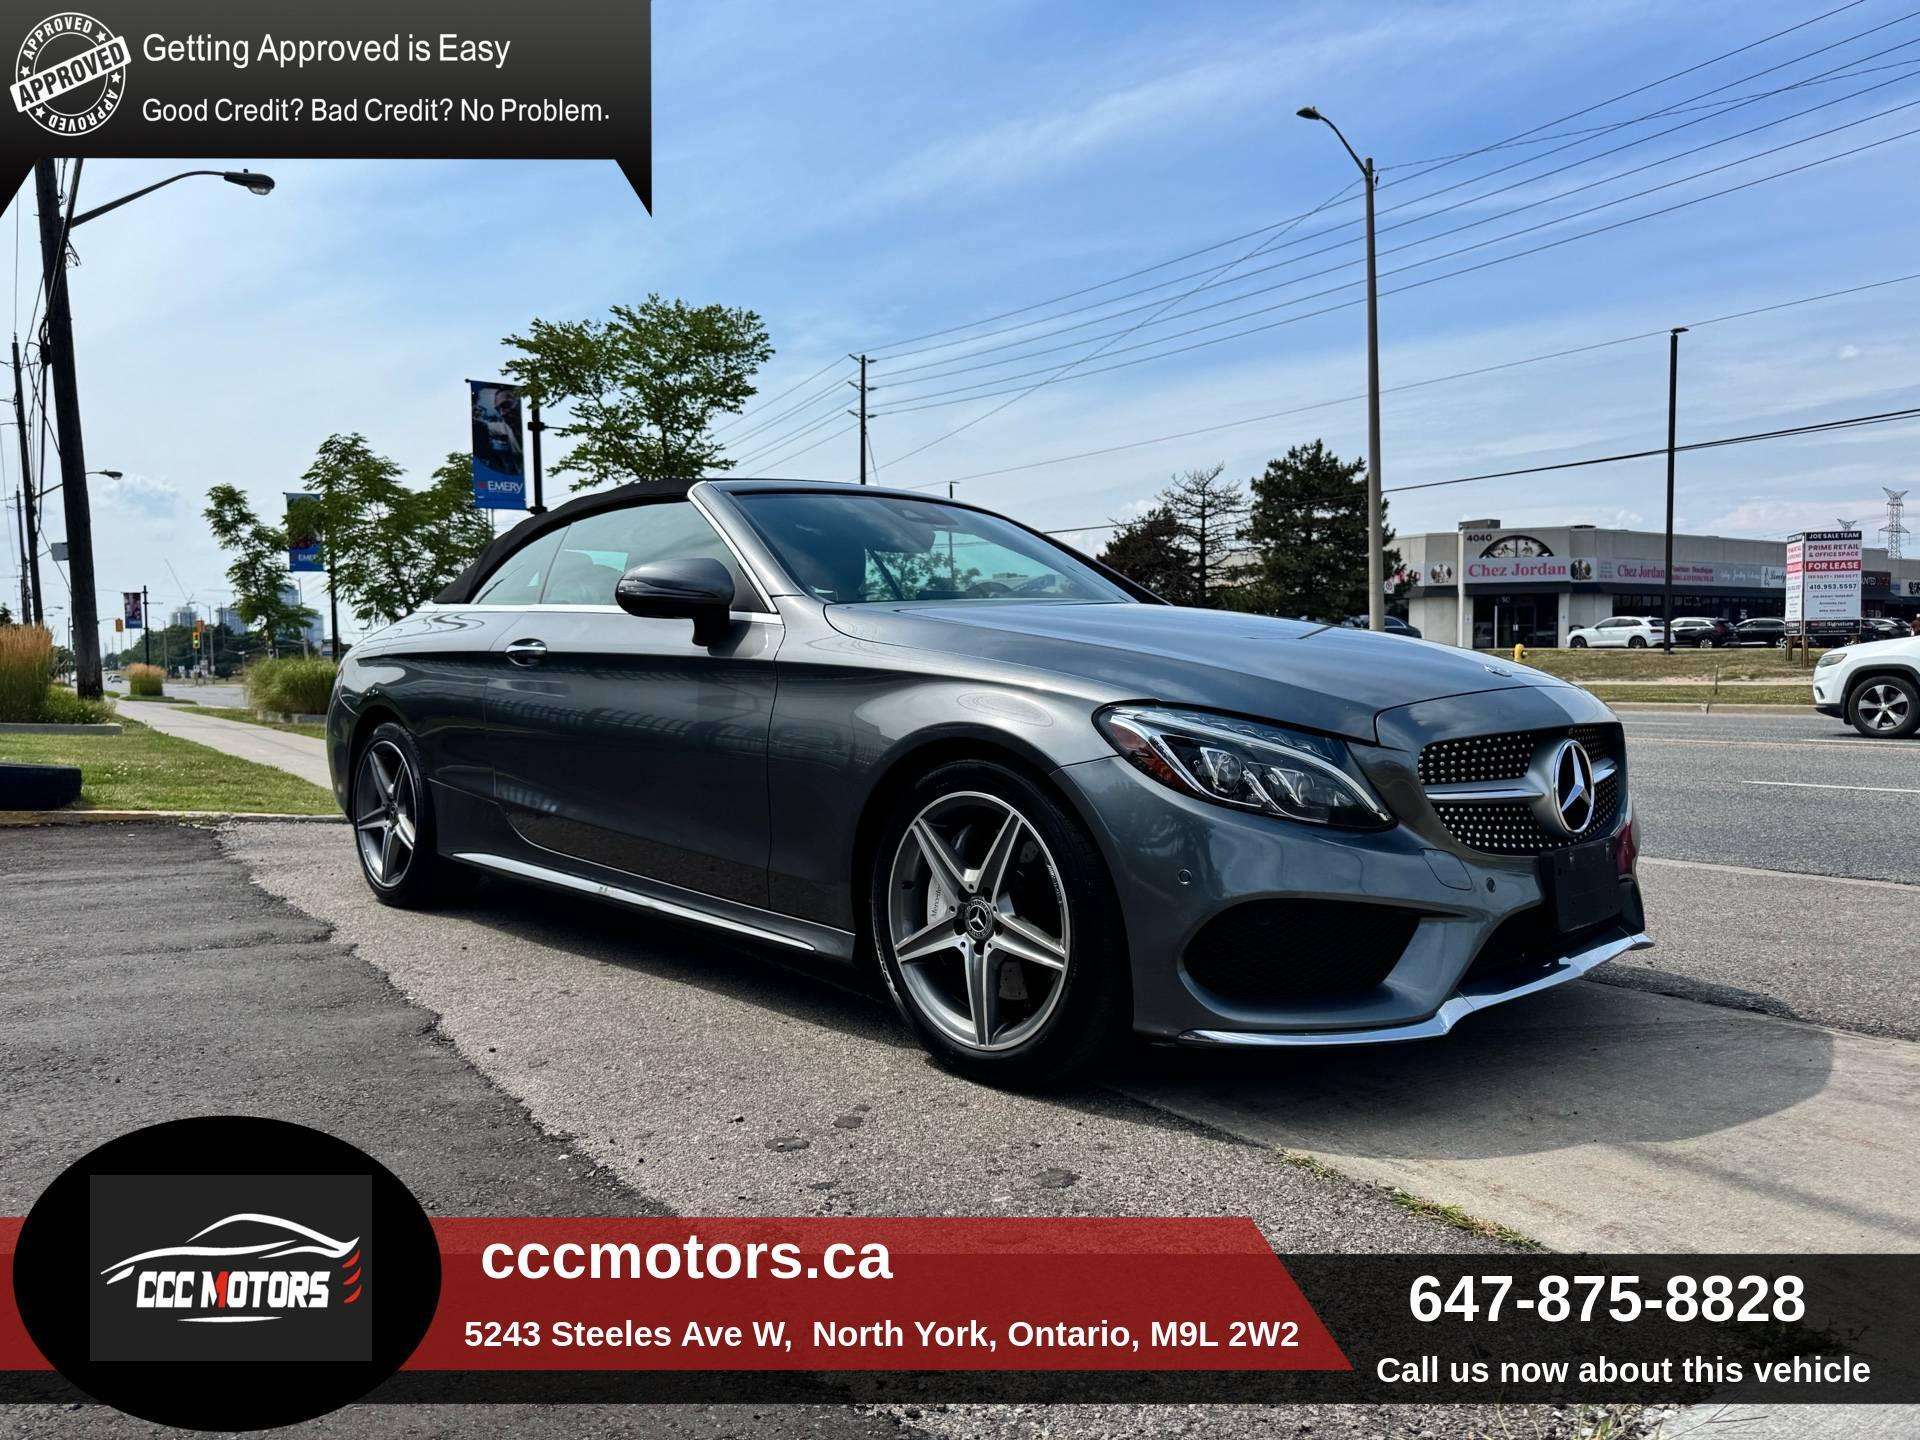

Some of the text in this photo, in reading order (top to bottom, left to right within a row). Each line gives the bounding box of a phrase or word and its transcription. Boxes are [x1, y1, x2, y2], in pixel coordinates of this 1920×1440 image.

[1467, 534, 1493, 542] 4040
[1468, 563, 1567, 577] Chez Jordan
[1617, 564, 1637, 577] Chez
[1638, 565, 1665, 578] Jordan
[1808, 562, 1829, 570] FOR
[1829, 561, 1859, 569] LEASE
